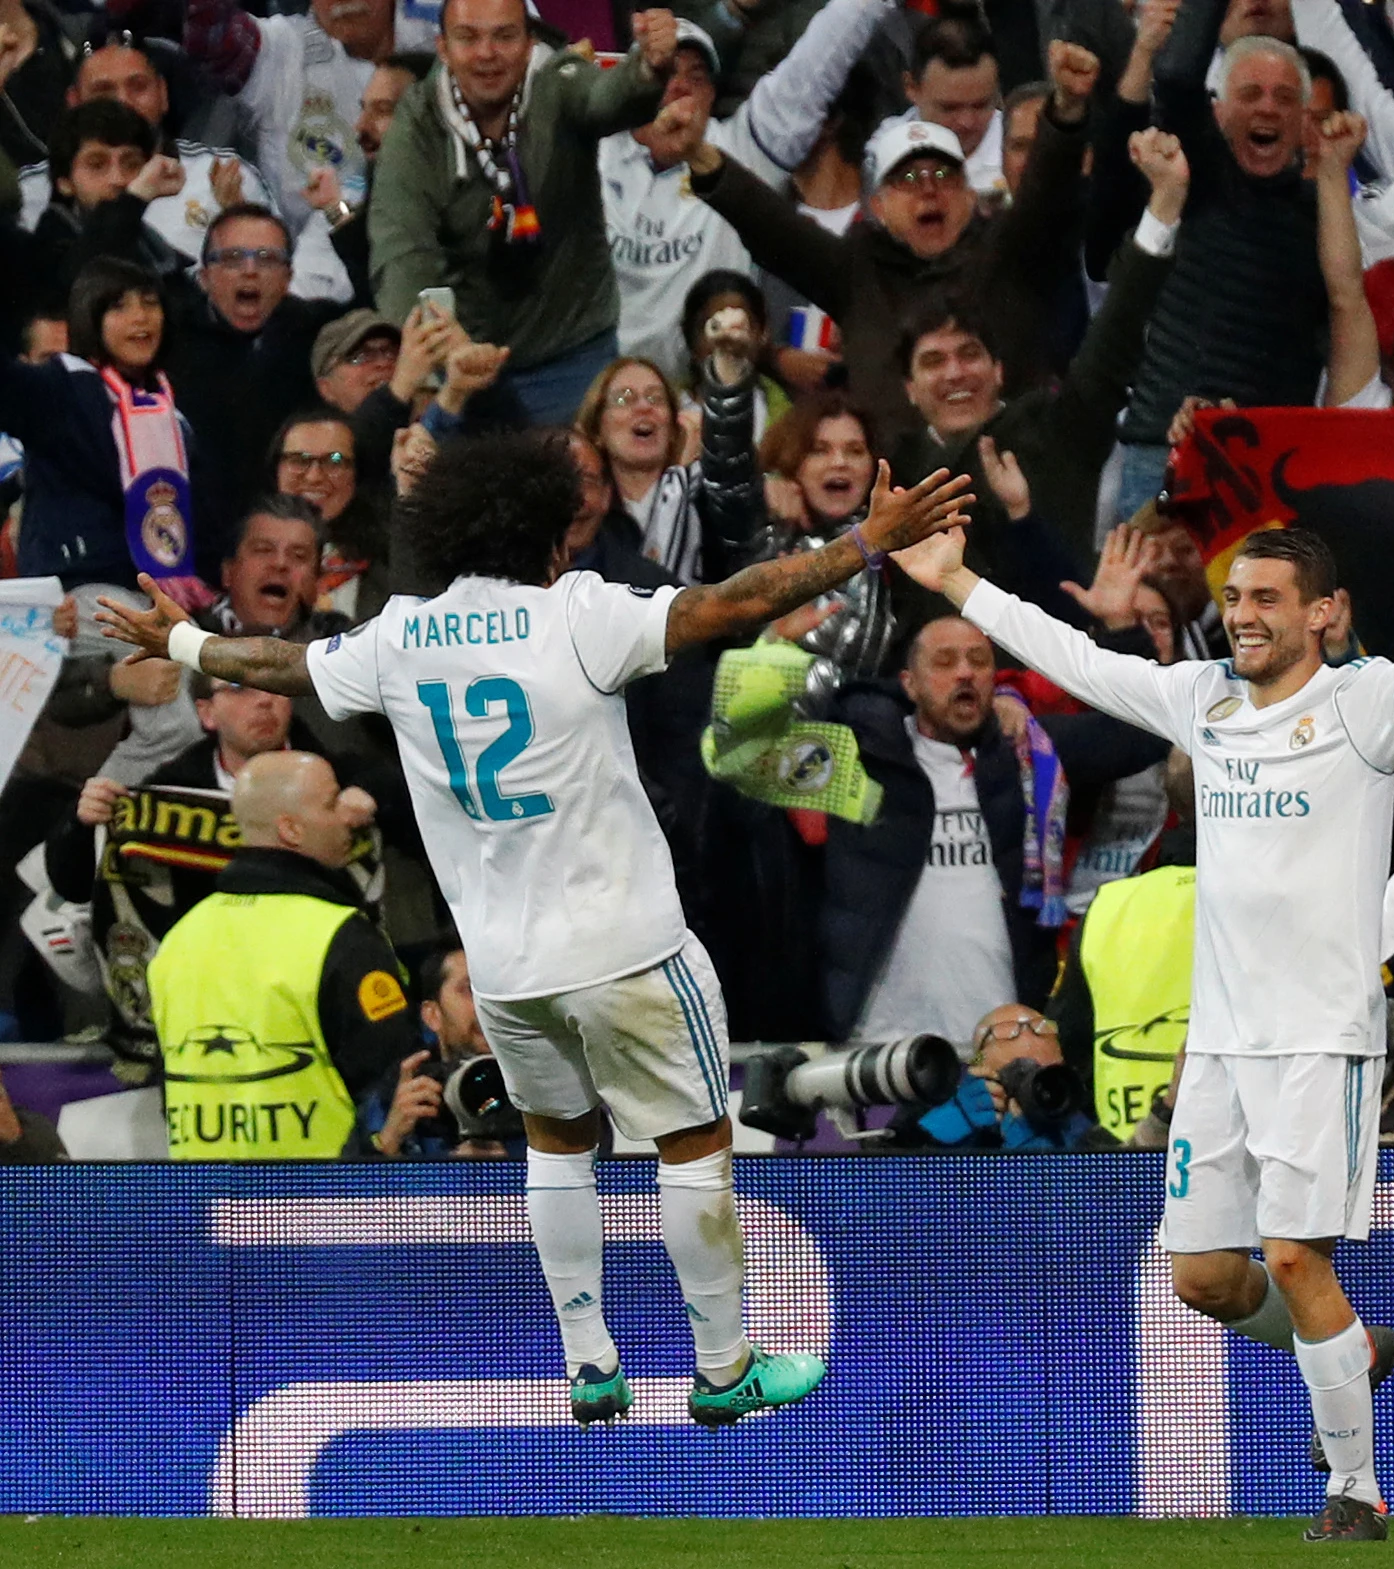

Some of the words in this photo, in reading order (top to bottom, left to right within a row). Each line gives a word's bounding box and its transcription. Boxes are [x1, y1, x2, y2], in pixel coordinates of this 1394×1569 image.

[610, 231, 704, 263] mirates
[403, 606, 531, 649] MARCELO
[417, 674, 555, 821] 12
[1226, 757, 1259, 784] Fly
[113, 793, 243, 848] alma
[1201, 785, 1310, 818] Emirates
[167, 1100, 318, 1145] ECURITY
